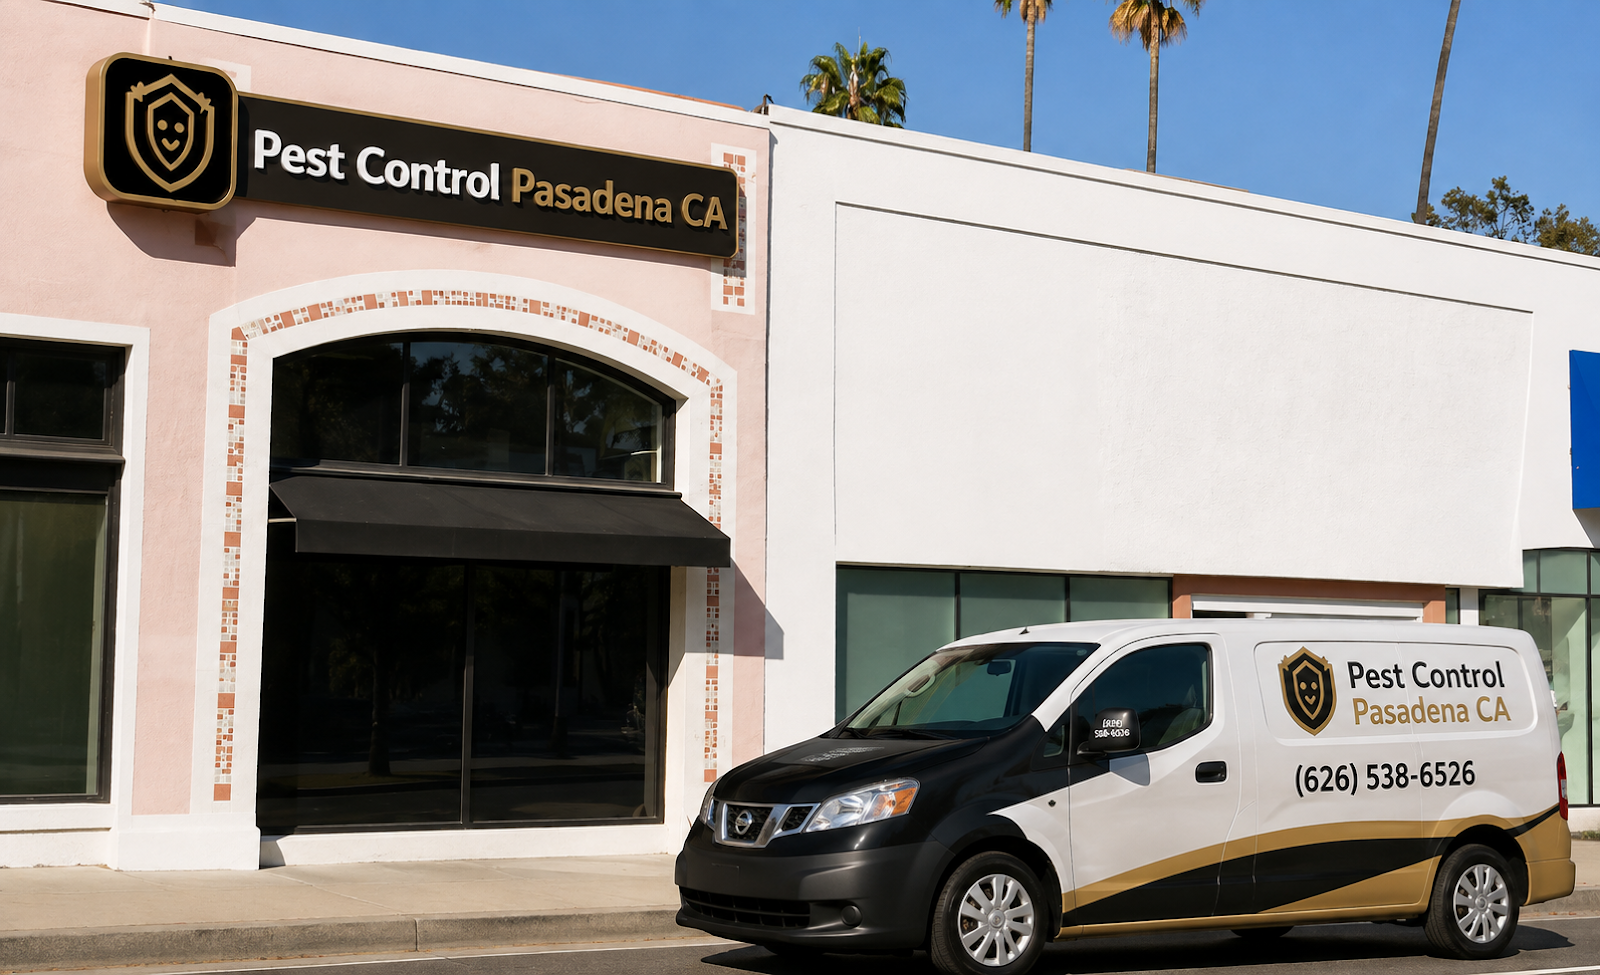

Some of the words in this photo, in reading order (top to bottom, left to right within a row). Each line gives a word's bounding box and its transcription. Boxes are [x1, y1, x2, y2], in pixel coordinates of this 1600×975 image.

[254, 129, 346, 180] Pest
[356, 146, 500, 201] Control
[511, 167, 673, 224] Pasadena
[681, 192, 728, 230] CA
[1347, 661, 1405, 688] Pest
[1412, 661, 1505, 688] Control
[1353, 696, 1469, 725] Pasadena
[1476, 696, 1511, 722] CA
[1296, 763, 1357, 797] (626)
[1366, 760, 1476, 790] 538-6526
